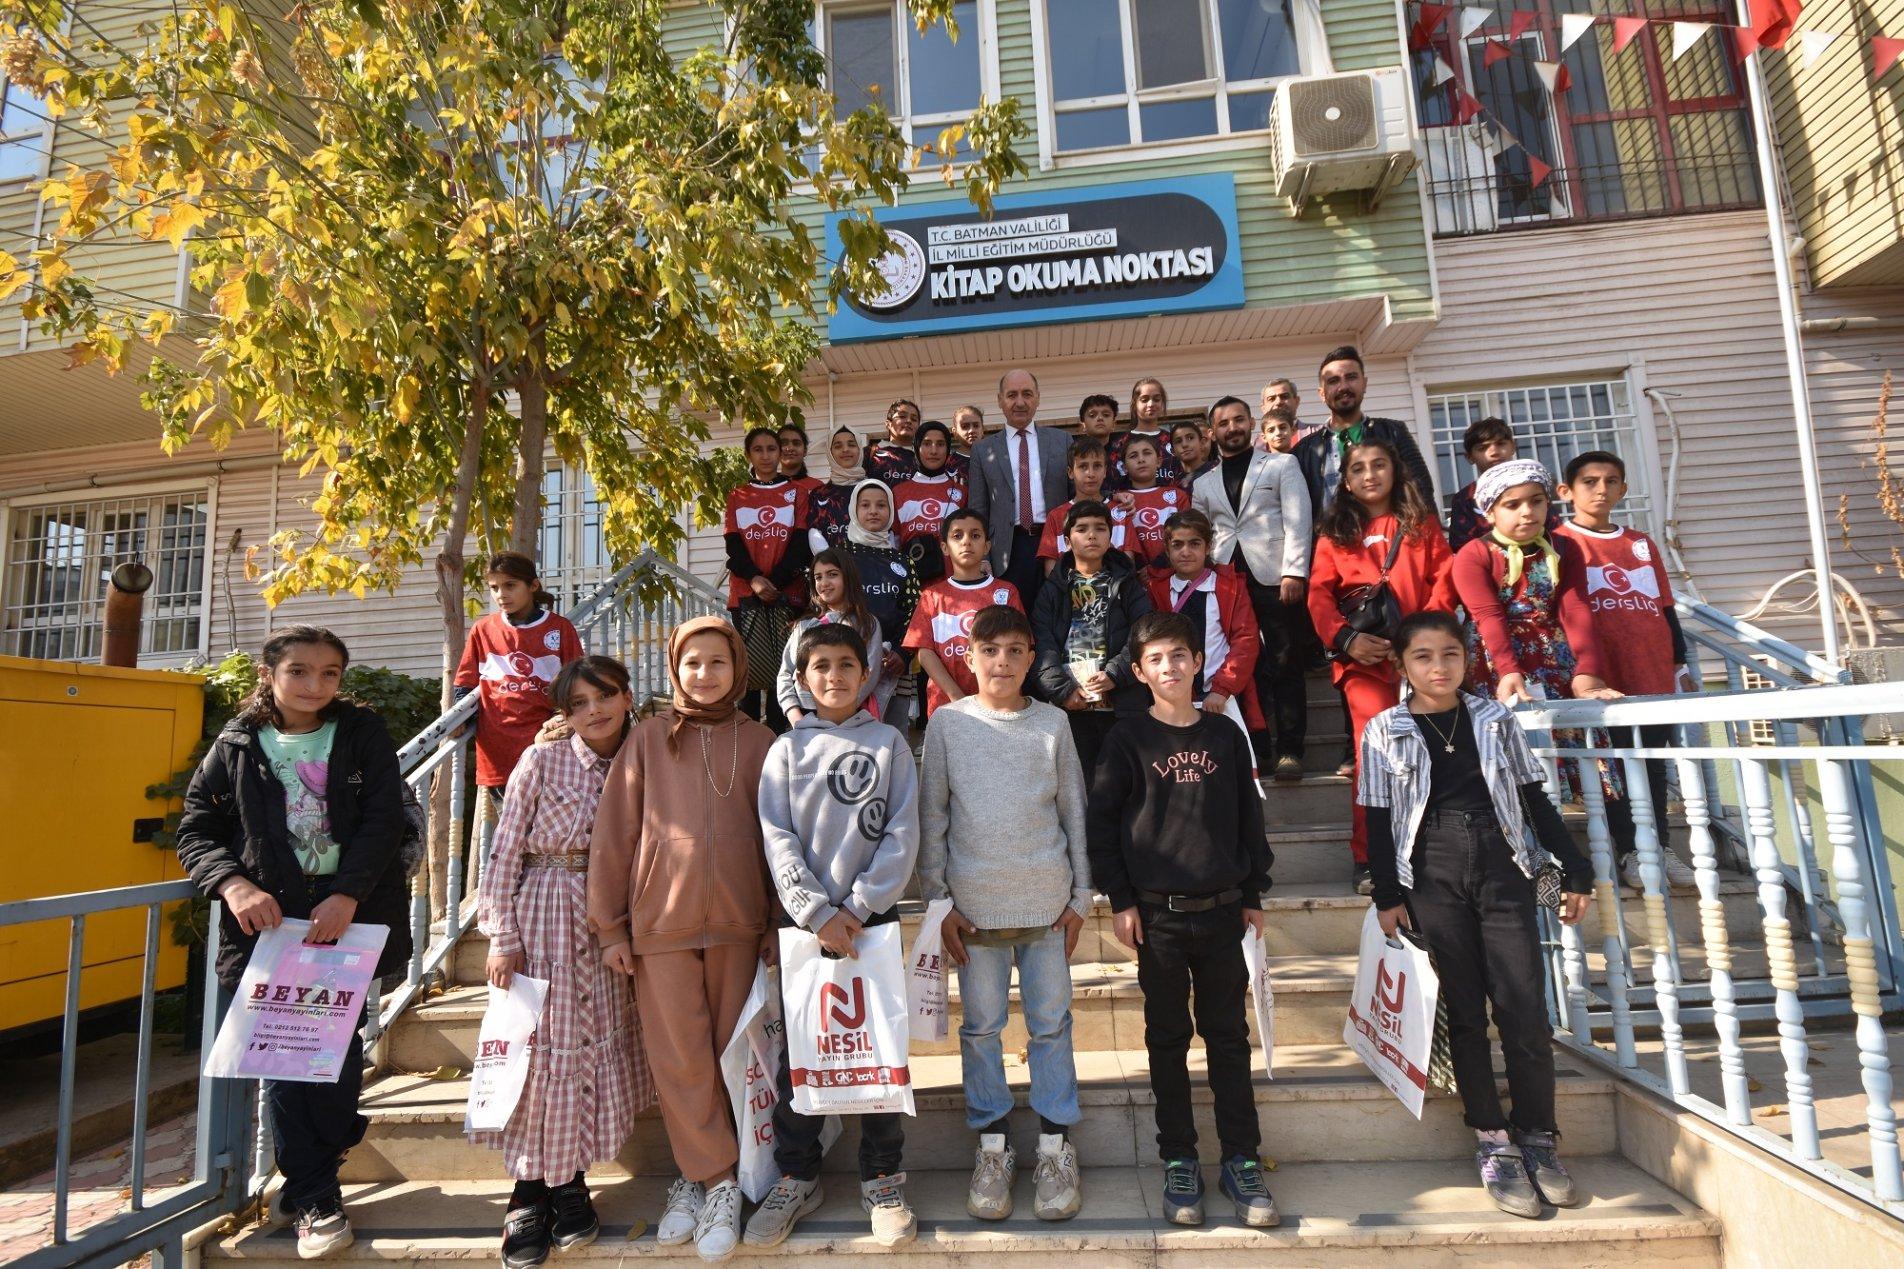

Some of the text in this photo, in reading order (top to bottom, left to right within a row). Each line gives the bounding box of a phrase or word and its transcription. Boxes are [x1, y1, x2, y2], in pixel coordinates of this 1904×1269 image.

[931, 216, 1063, 243] T.C. BATMAN VALİLİĞİ
[932, 231, 1113, 260] İL MİLLİ EĞİTİM MÜDÜRLÜĞÜ
[930, 265, 1003, 300] KİTAP
[1007, 256, 1101, 293] OKUMA
[1105, 246, 1214, 285] NOKTASI
[745, 526, 788, 541] derslig
[1152, 750, 1219, 778] Lovely
[1174, 768, 1201, 783] Life
[251, 983, 354, 1007] BEYAN
[247, 1004, 346, 1018] www.beyanyayinlari.com
[843, 1052, 873, 1061] GRUBU
